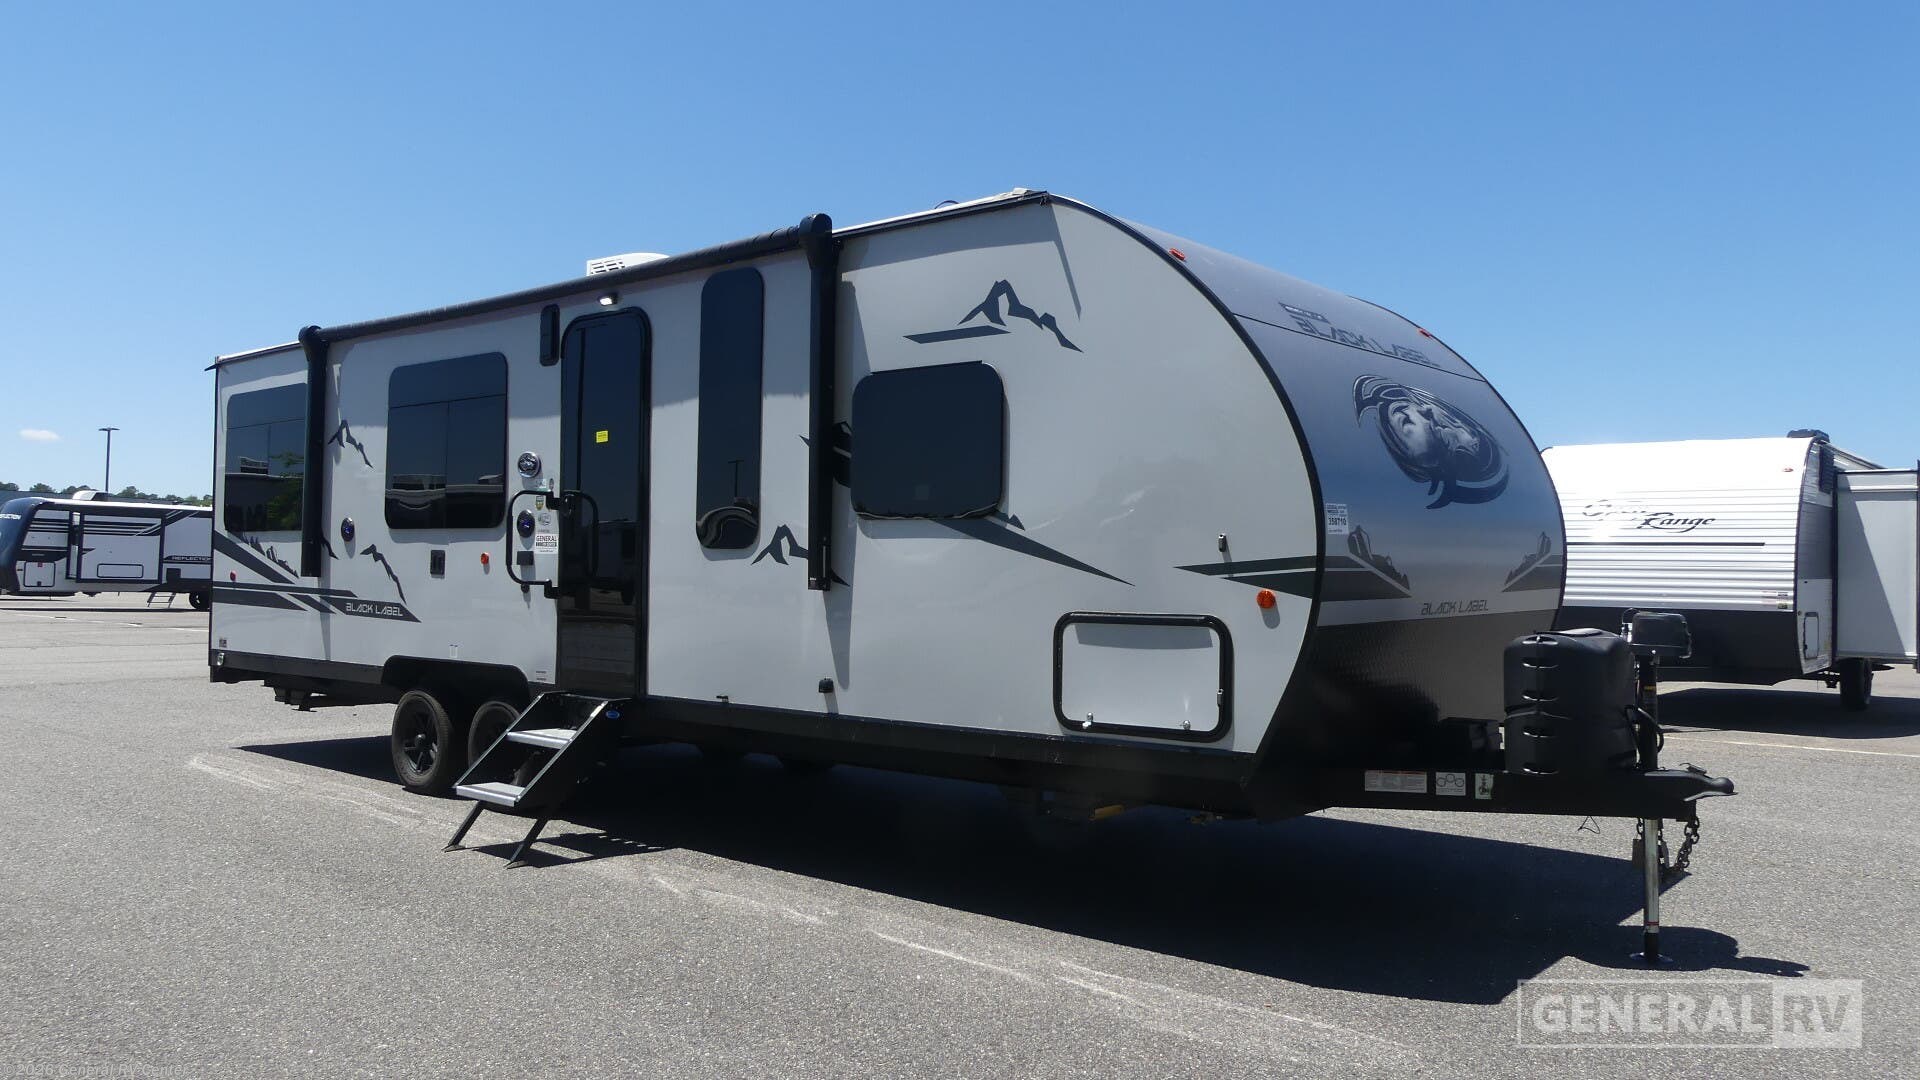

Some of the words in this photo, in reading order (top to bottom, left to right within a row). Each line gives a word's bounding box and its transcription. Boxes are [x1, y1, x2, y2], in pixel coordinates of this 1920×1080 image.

[1289, 314, 1375, 350] BLACK
[1636, 512, 1716, 533] Range
[345, 602, 374, 613] BLACK
[375, 605, 404, 617] LABEL
[1420, 601, 1457, 616] BLACK
[1458, 599, 1489, 613] LABEL
